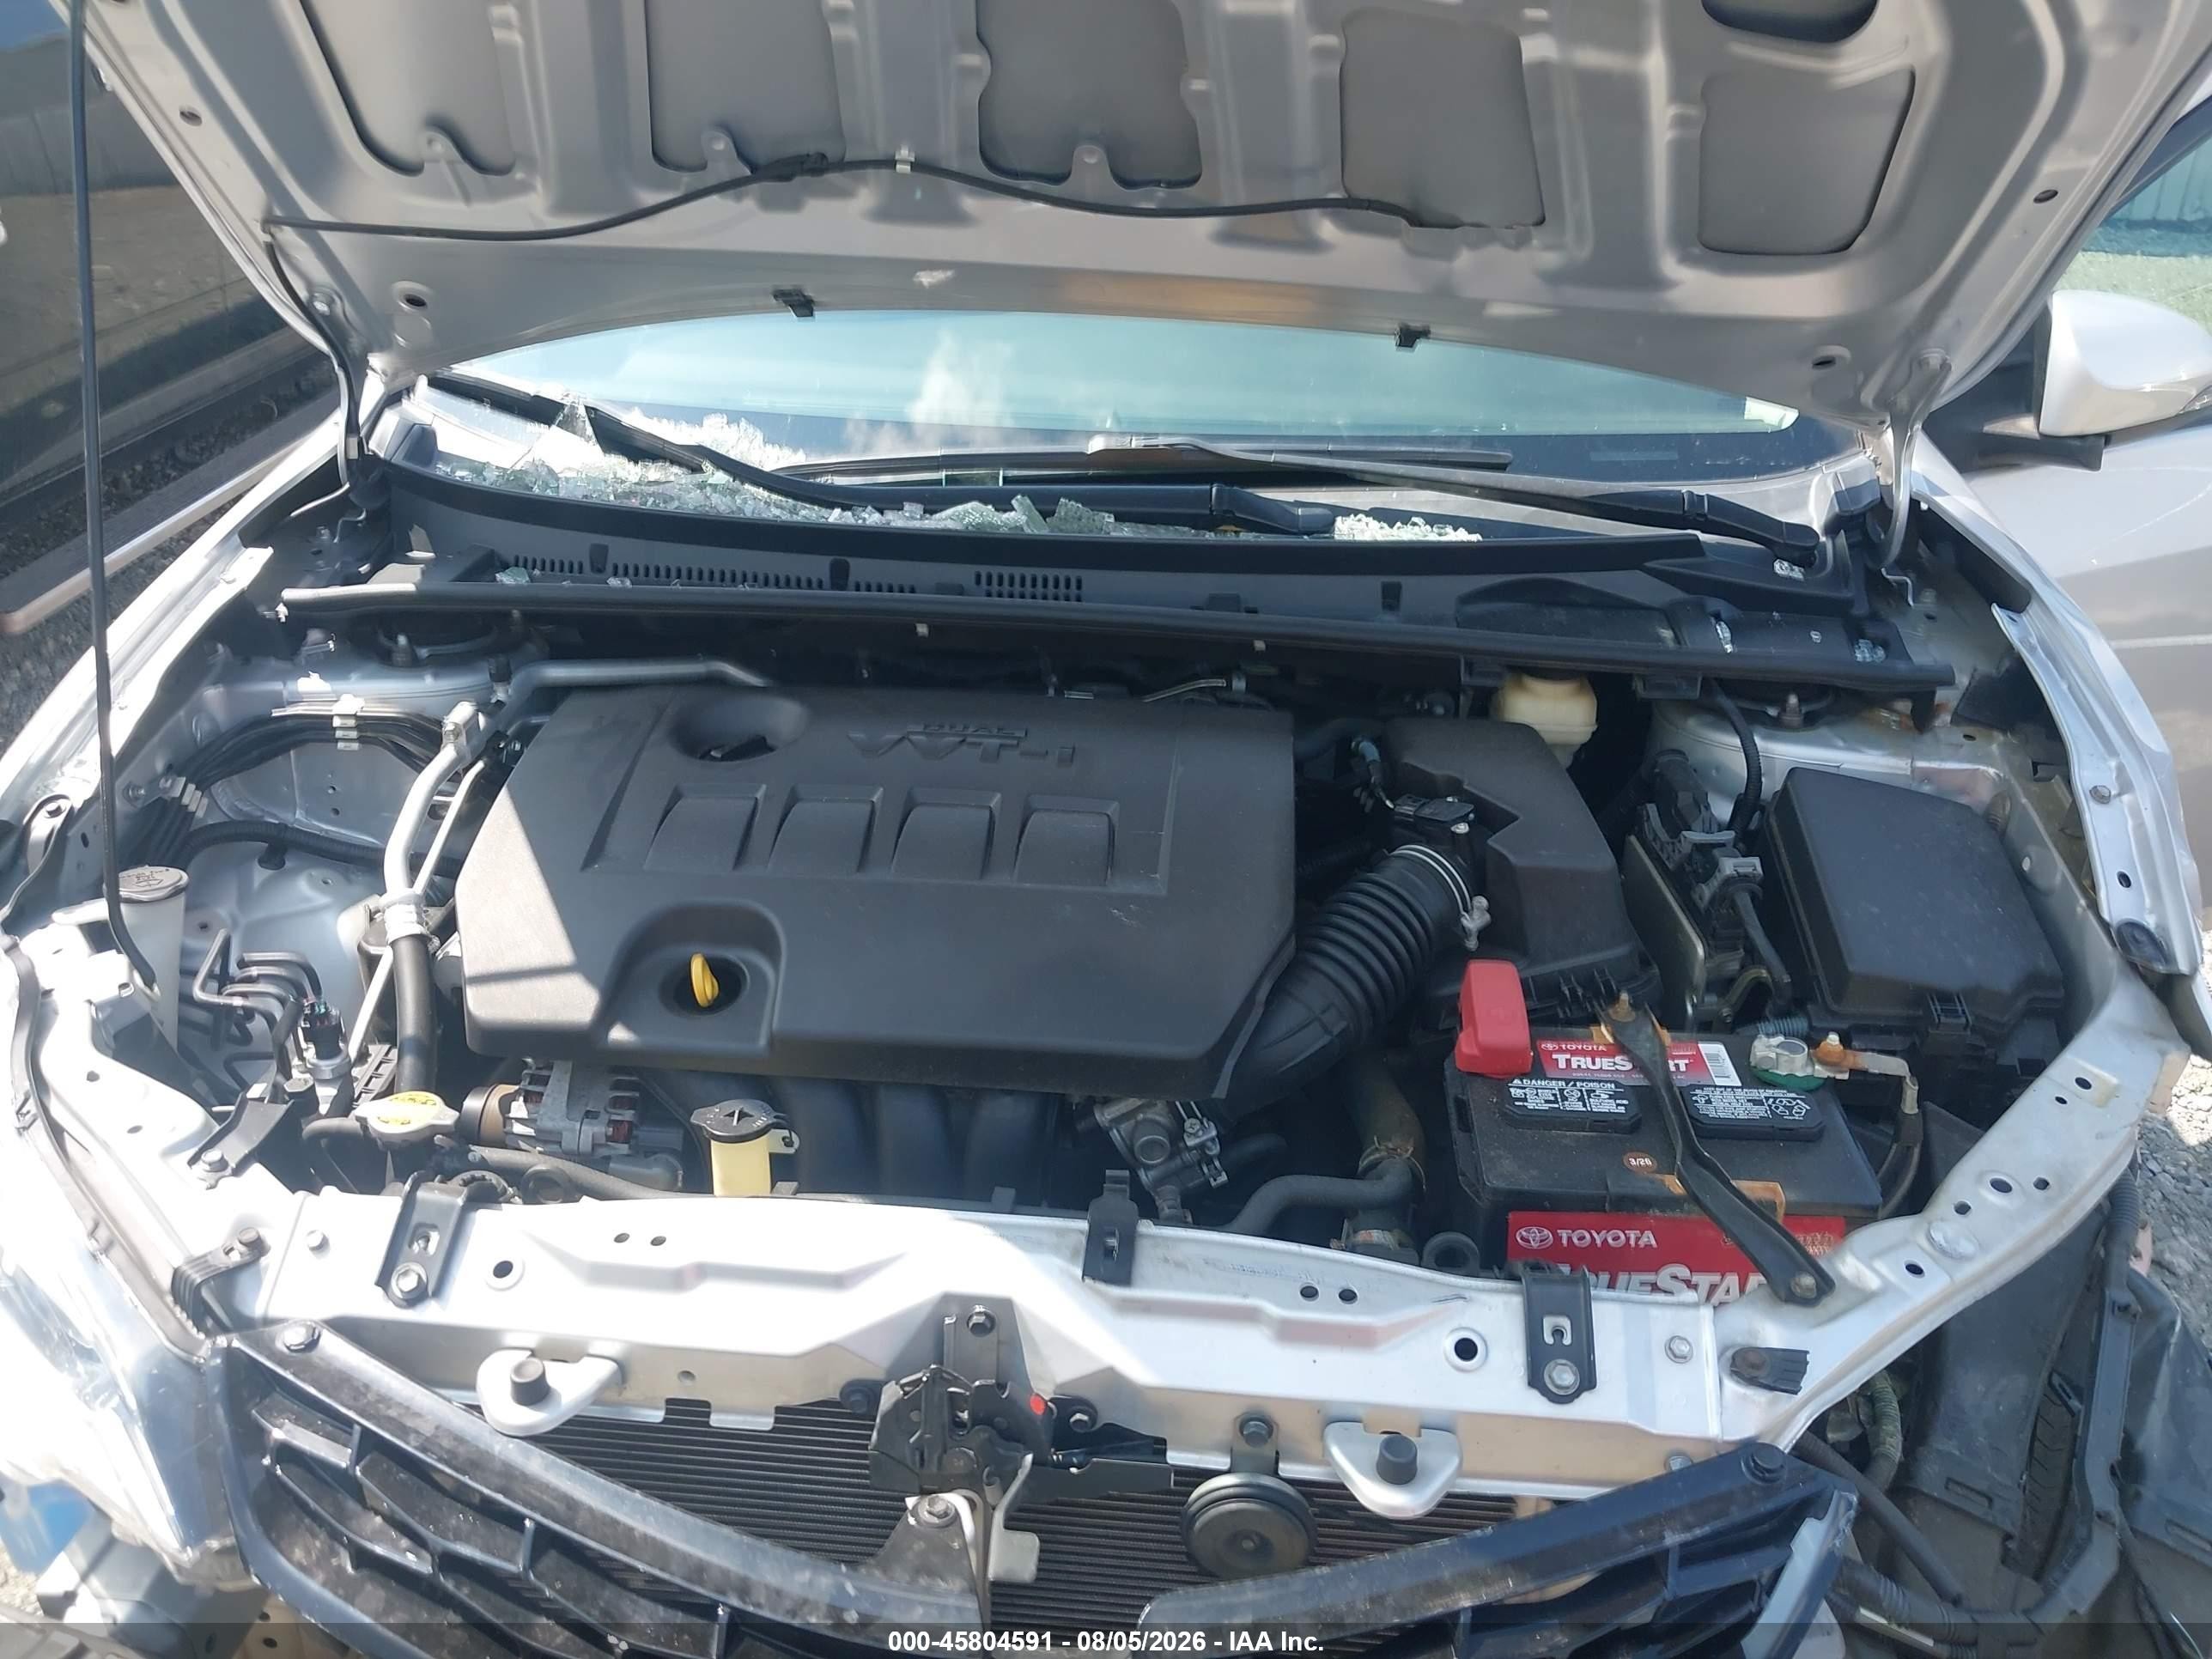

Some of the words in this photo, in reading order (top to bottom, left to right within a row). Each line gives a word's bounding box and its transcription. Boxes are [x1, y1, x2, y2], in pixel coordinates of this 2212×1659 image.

[1560, 1043, 1607, 1052] TOYOTA
[1522, 1079, 1565, 1088] DANGER
[1577, 1080, 1615, 1090] POISON
[1556, 1229, 1658, 1249] TOYOTA
